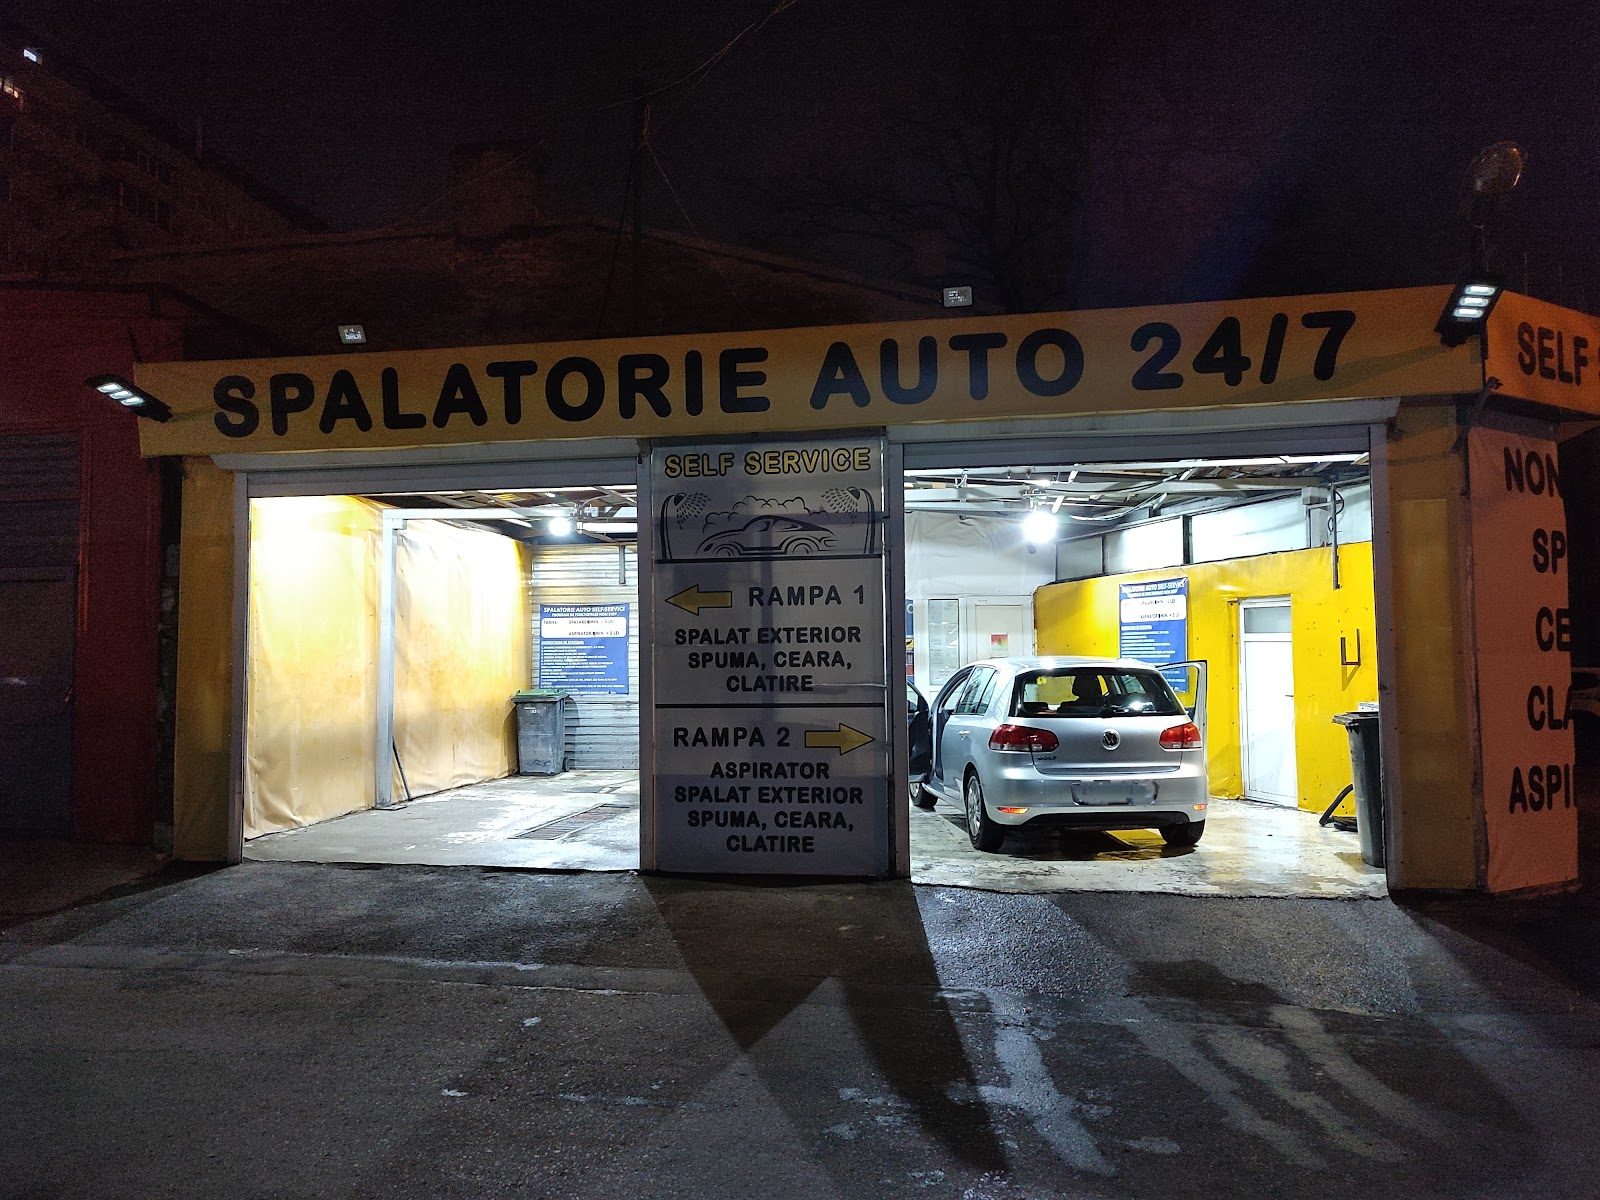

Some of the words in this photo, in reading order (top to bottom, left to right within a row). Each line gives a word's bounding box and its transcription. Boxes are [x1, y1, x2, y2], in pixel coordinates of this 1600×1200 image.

[1517, 321, 1589, 387] SELF
[213, 347, 770, 438] SPALATORIE
[810, 328, 1085, 409] AUTO
[1130, 310, 1357, 391] 24/7
[665, 453, 734, 478] SELF
[744, 447, 871, 475] SERVICE
[1533, 528, 1566, 575] SP
[749, 585, 842, 606] RAMPA
[853, 585, 864, 605] 1
[675, 628, 750, 645] SPALAT
[757, 627, 861, 644] EXTERIOR
[688, 652, 766, 671] SPUMA,
[774, 651, 852, 670] CEARA,
[727, 675, 814, 692] CLATIRE
[673, 727, 765, 747] RAMPA
[777, 727, 790, 747] 2
[710, 762, 830, 779] ASPIRATOR
[675, 786, 750, 803] SPALAT
[758, 786, 863, 804] EXTERIOR
[688, 810, 767, 830] SPUMA,
[774, 811, 854, 831] CEARA,
[727, 835, 815, 853] CLATIRE
